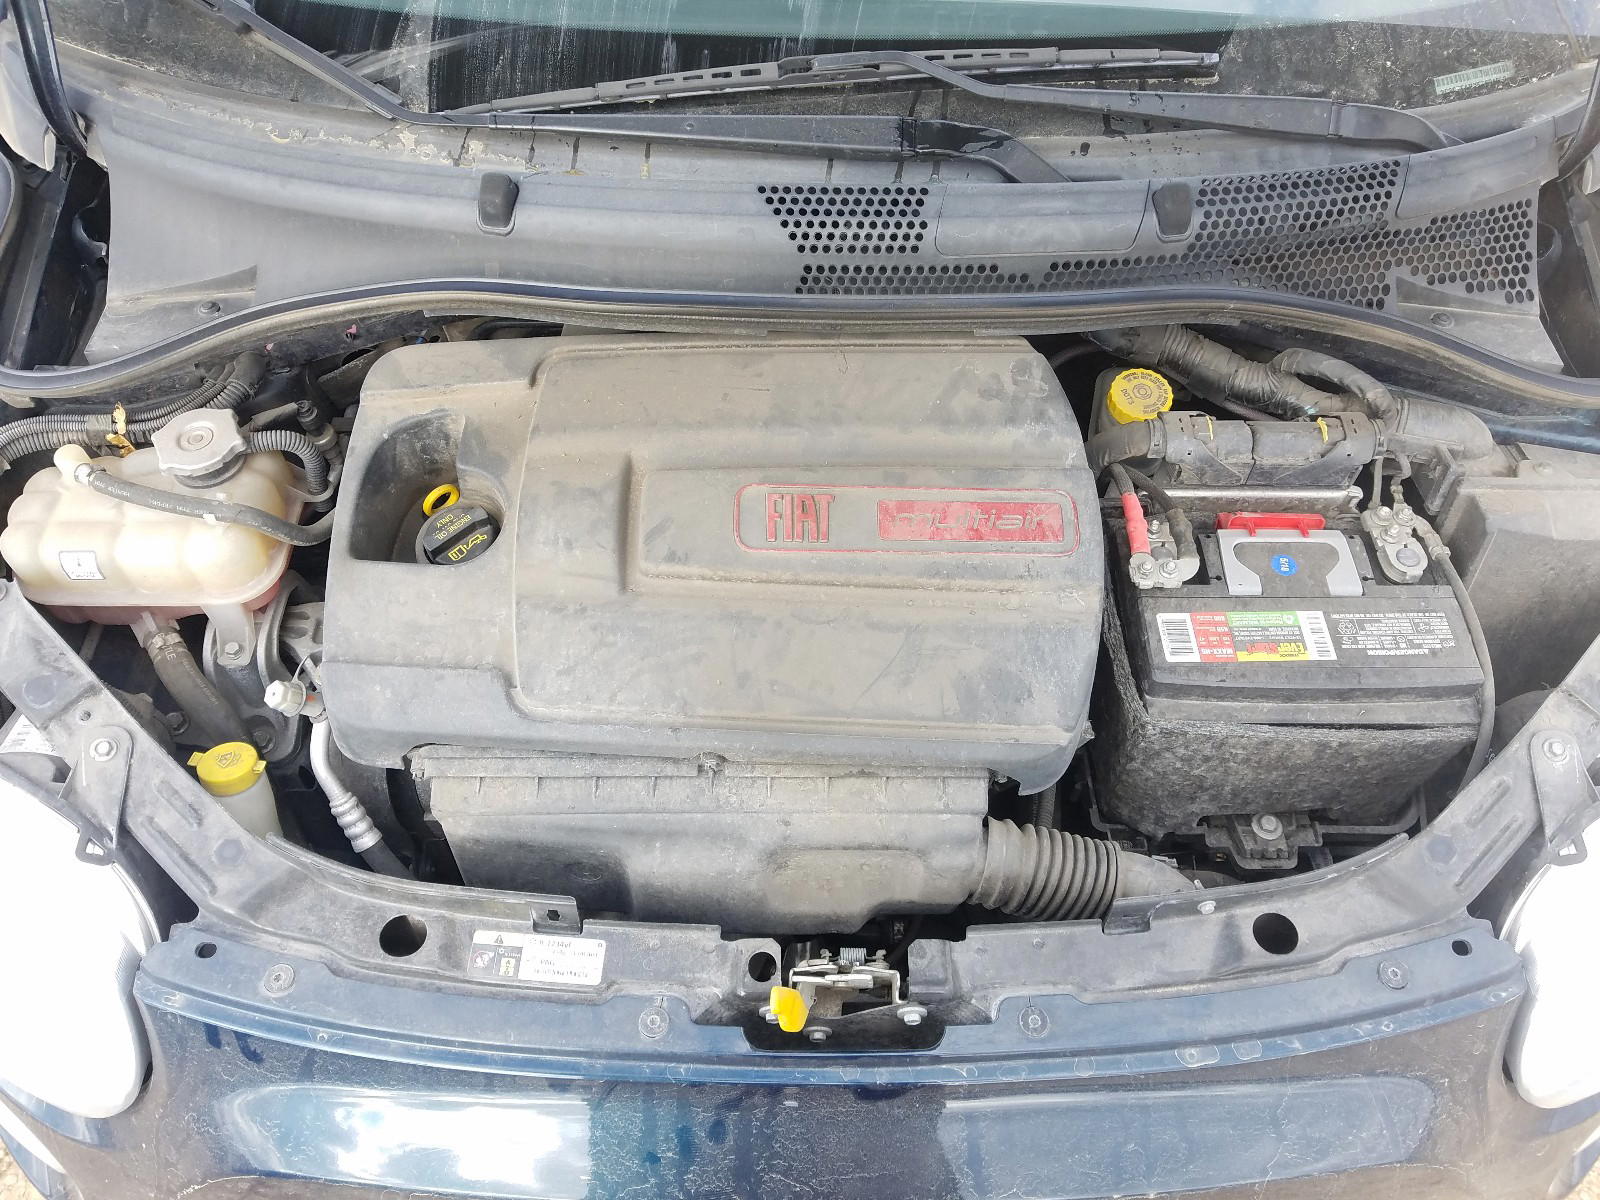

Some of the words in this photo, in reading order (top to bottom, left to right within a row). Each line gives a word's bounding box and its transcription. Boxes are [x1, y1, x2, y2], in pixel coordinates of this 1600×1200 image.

[437, 513, 454, 529] ONLY
[447, 514, 472, 533] ENGINE
[765, 492, 835, 543] FIAT
[435, 530, 448, 540] OIL
